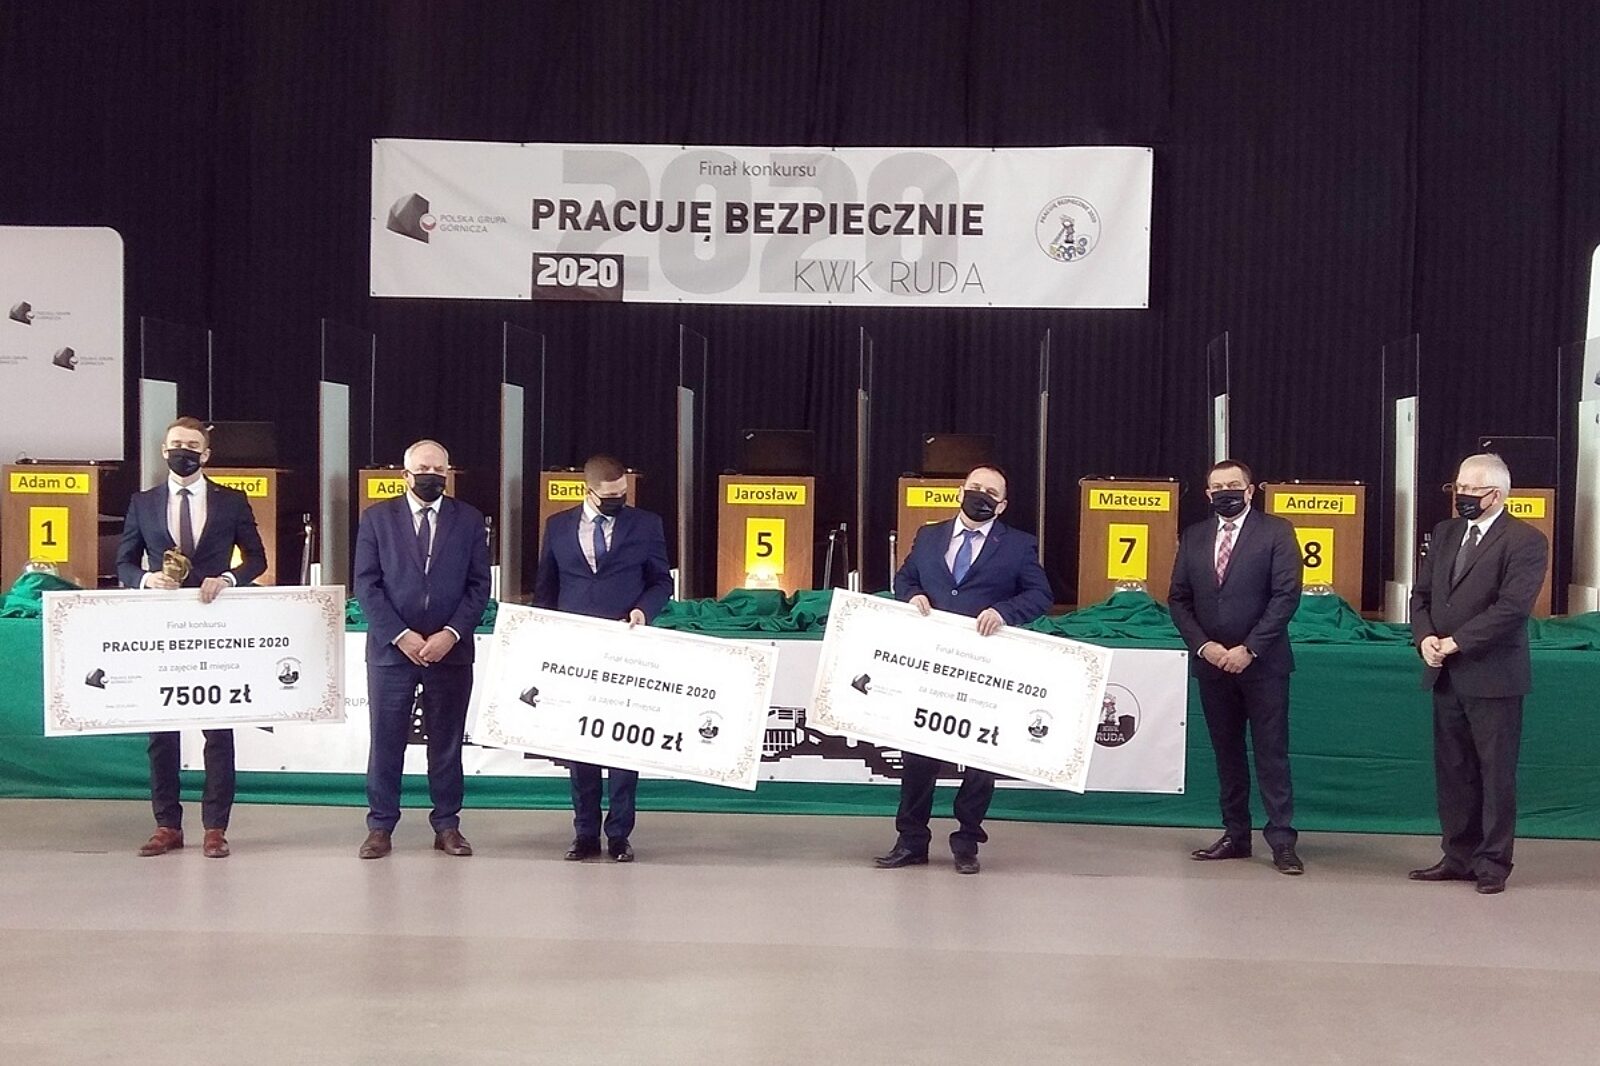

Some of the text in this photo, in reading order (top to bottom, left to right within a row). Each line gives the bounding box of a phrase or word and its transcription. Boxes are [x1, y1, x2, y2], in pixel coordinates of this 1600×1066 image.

[699, 160, 817, 178] Finał konkursu
[440, 214, 507, 224] POLSKA GRUPA
[531, 198, 984, 242] PRACUJĘ BEZPIECZNIE
[536, 257, 619, 287] 2020
[794, 261, 985, 294] KWK RUDA
[18, 477, 81, 490] Adam O.
[734, 486, 797, 502] Jarosław
[924, 490, 961, 504] Pawe
[1098, 493, 1161, 507] Mateusz
[1286, 496, 1344, 513] Andrzej
[1503, 500, 1533, 513] ian
[41, 520, 57, 546] 1
[755, 532, 773, 558] 5
[1119, 537, 1136, 564] 7
[1302, 541, 1322, 567] 8
[166, 620, 226, 629] Finał konkursu
[102, 636, 290, 653] PRACUJĘ BEZPIECZNIE 2020
[199, 661, 208, 671] II
[209, 663, 240, 671] miejsca
[873, 649, 931, 675] PRACUJĘ
[932, 662, 1015, 691] BEZPIECZNIE
[1016, 682, 1048, 699] 2020
[541, 661, 717, 700] PRACUJĘ BEZPIECZNIE 2020
[159, 683, 252, 707] 7500 zł
[626, 698, 632, 708] I
[956, 691, 968, 703] III
[578, 716, 605, 738] 10
[611, 721, 655, 747] 000
[661, 732, 683, 752] zł
[913, 707, 1000, 747] 5000 zł
[1096, 732, 1125, 742] RUDA
